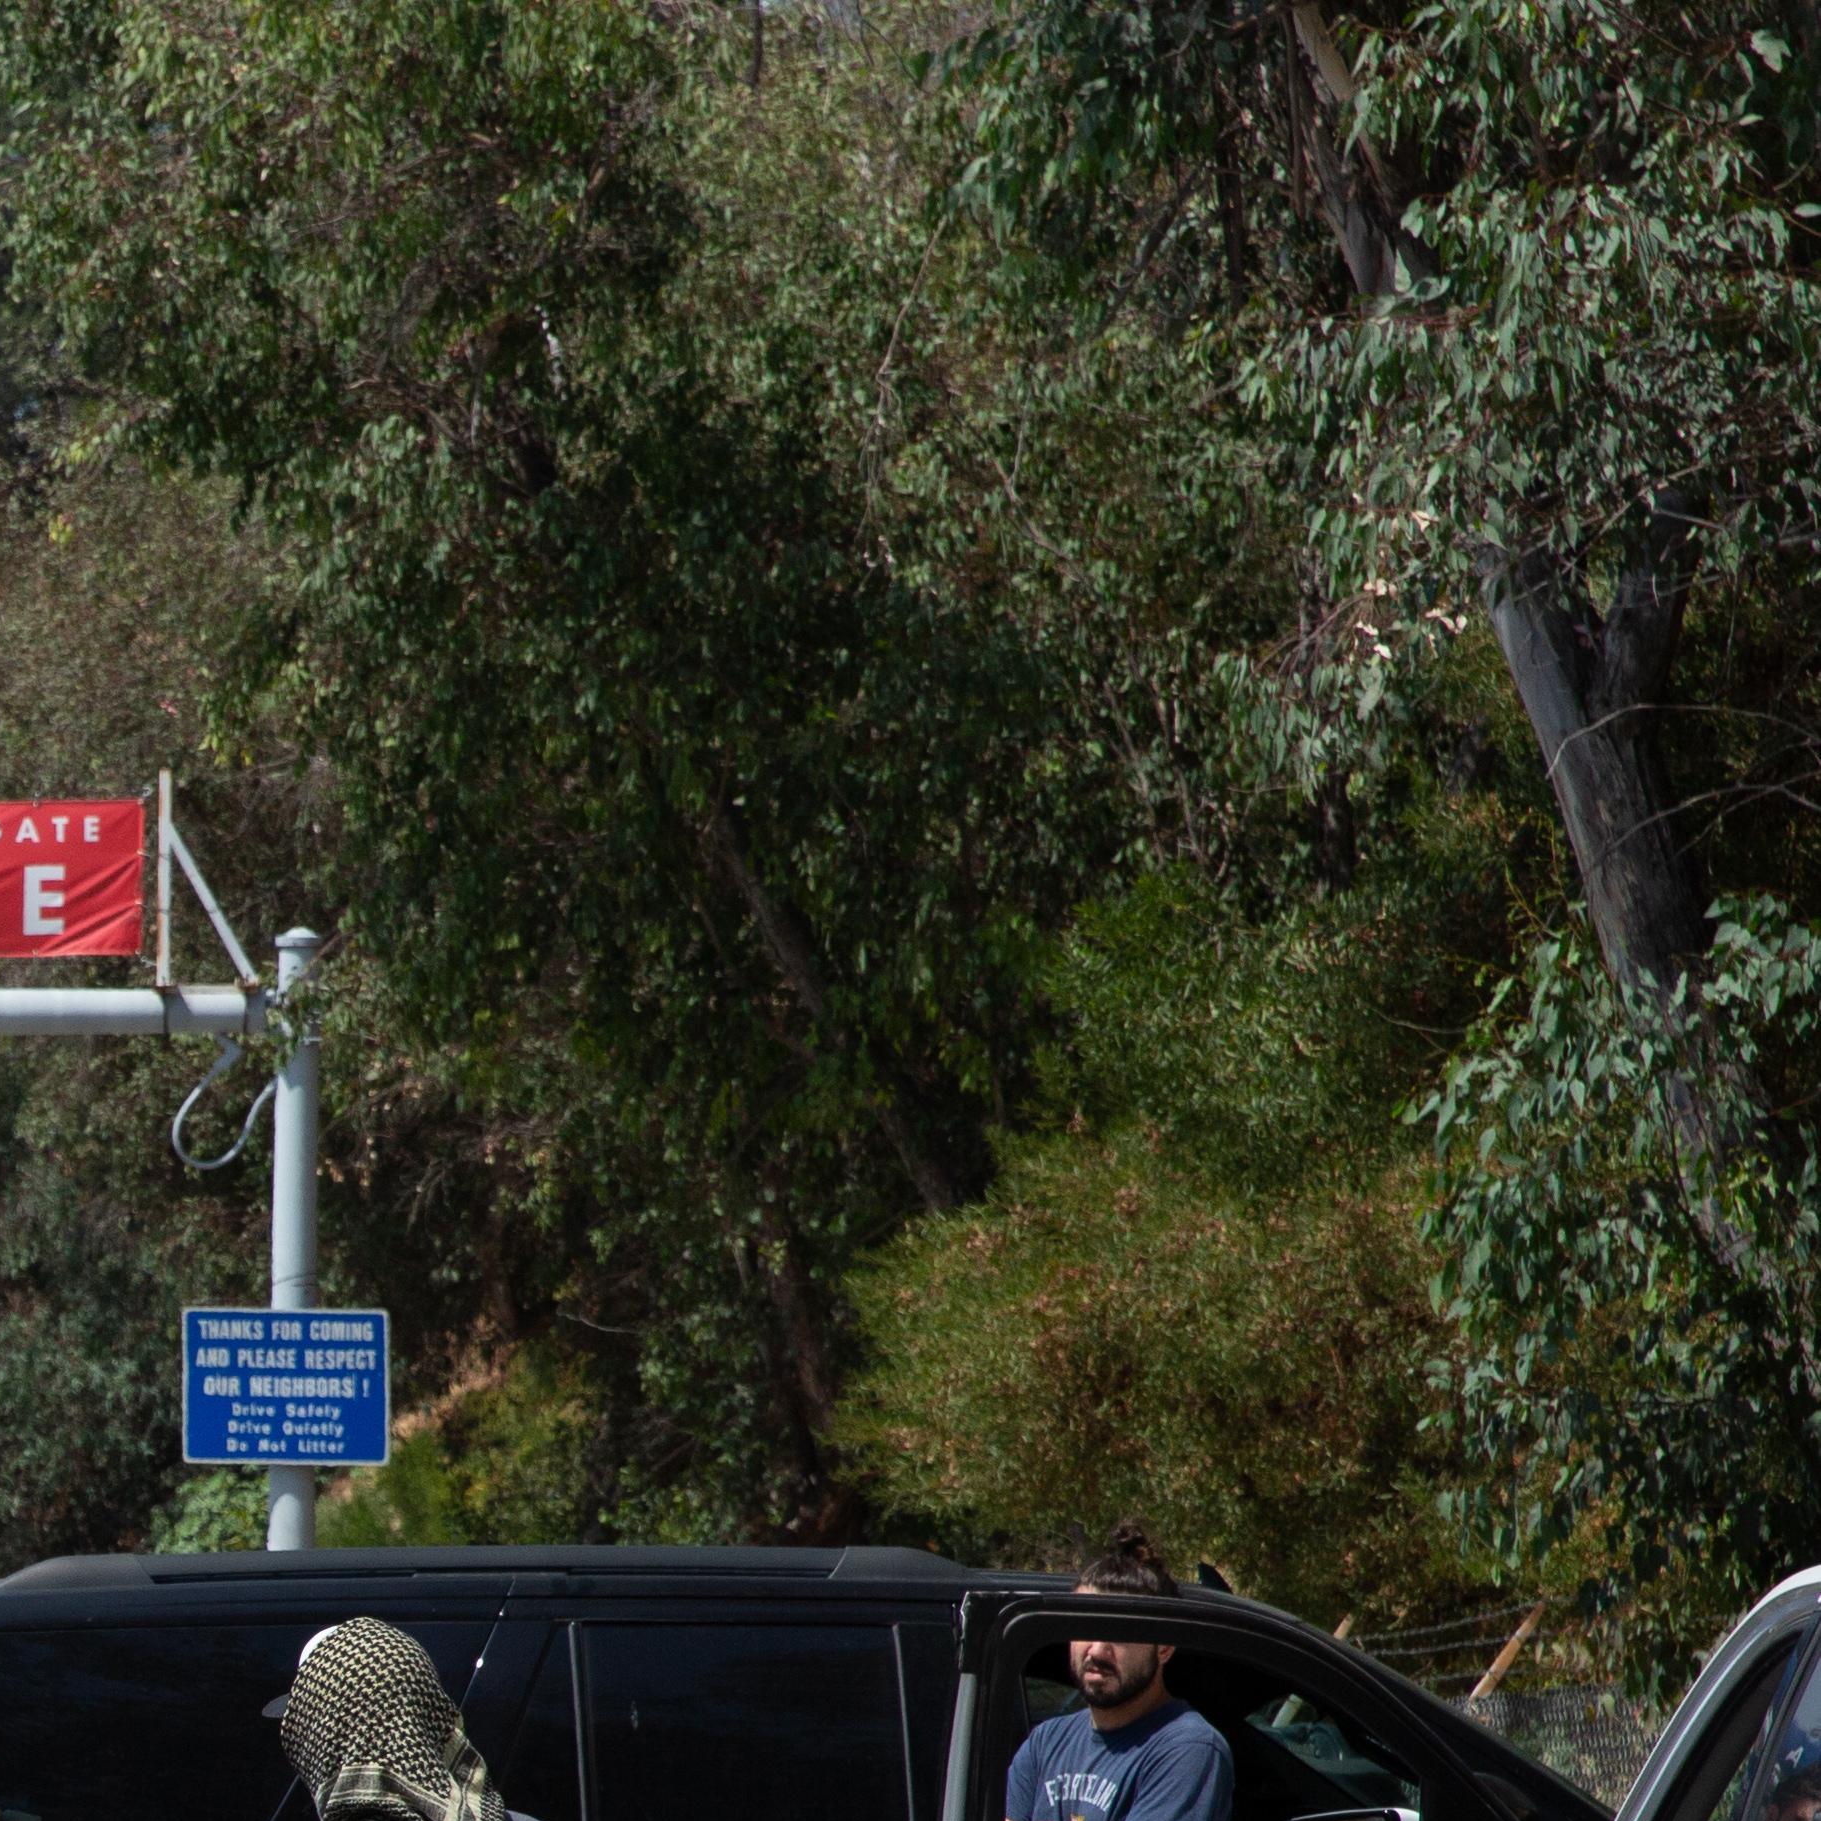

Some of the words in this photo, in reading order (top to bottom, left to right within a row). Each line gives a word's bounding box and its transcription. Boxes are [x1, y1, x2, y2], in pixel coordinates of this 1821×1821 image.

[22, 864, 65, 936] E
[197, 1319, 265, 1341] THANKS
[271, 1320, 302, 1342] FOR
[309, 1320, 374, 1342] COMING
[195, 1347, 231, 1368] AND
[237, 1348, 297, 1370] PLEASE
[304, 1348, 376, 1371] RESPECT
[203, 1376, 241, 1397] OUR
[231, 1403, 276, 1418] Drive
[285, 1403, 342, 1421] Safely
[227, 1420, 271, 1436] Drive
[282, 1420, 345, 1438] Quietly
[225, 1437, 249, 1453] Do
[258, 1438, 287, 1453] Not
[298, 1439, 345, 1454] Litter
